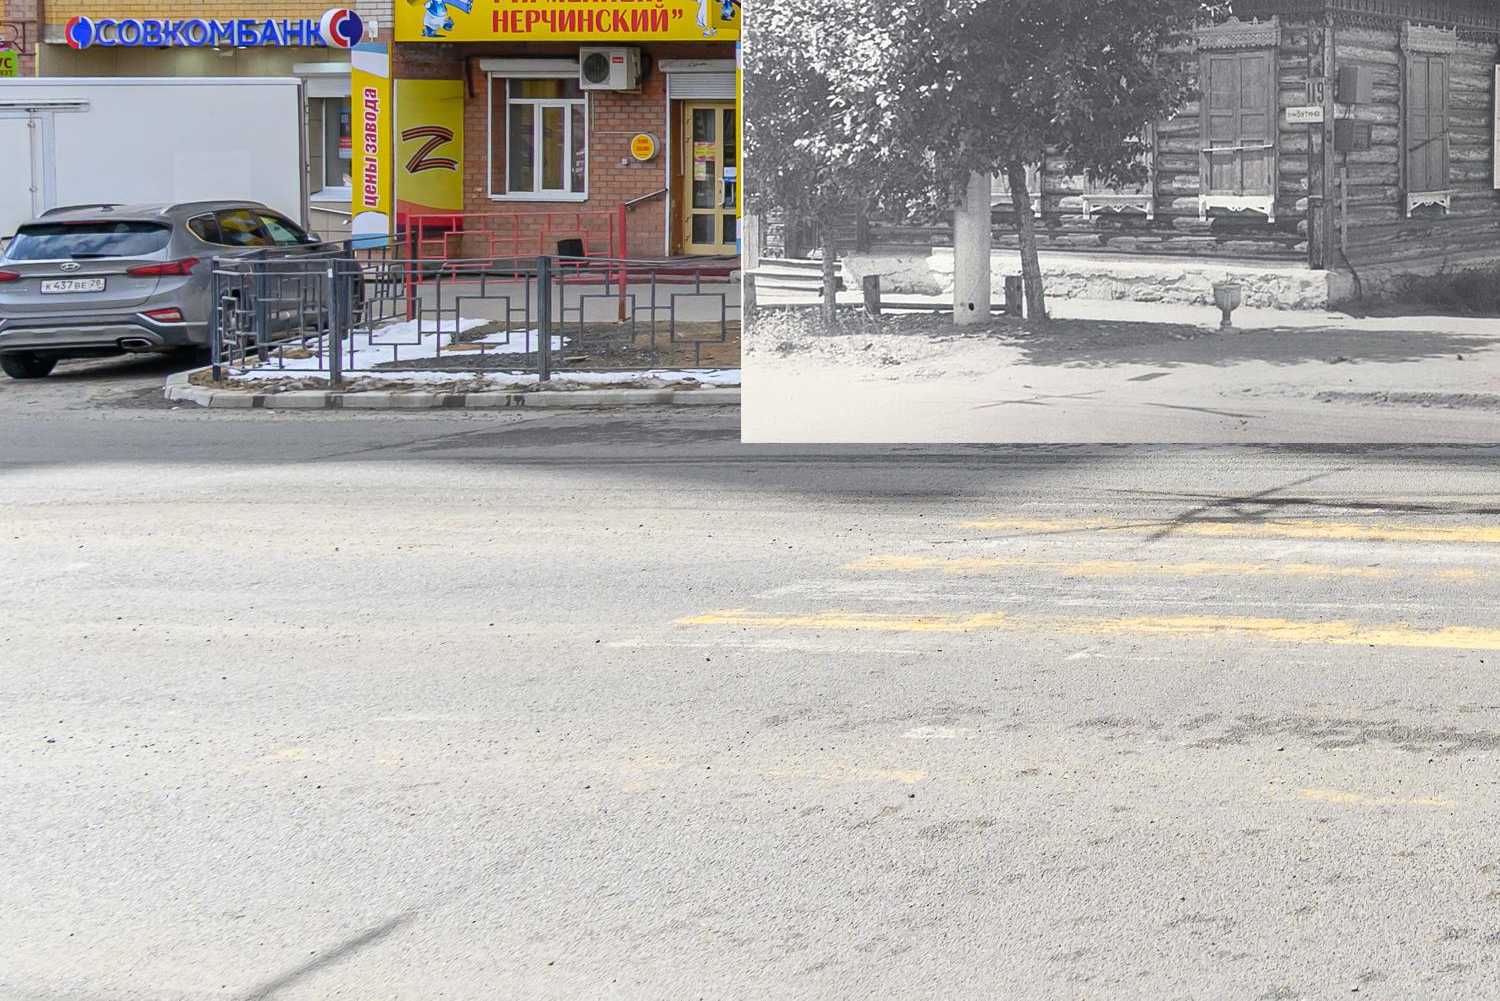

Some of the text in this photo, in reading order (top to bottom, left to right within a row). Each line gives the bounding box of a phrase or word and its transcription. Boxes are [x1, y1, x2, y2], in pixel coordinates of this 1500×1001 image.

[97, 19, 324, 46] СОВКОМБАНК
[1307, 81, 1325, 103] 119
[364, 88, 380, 207] цены завода
